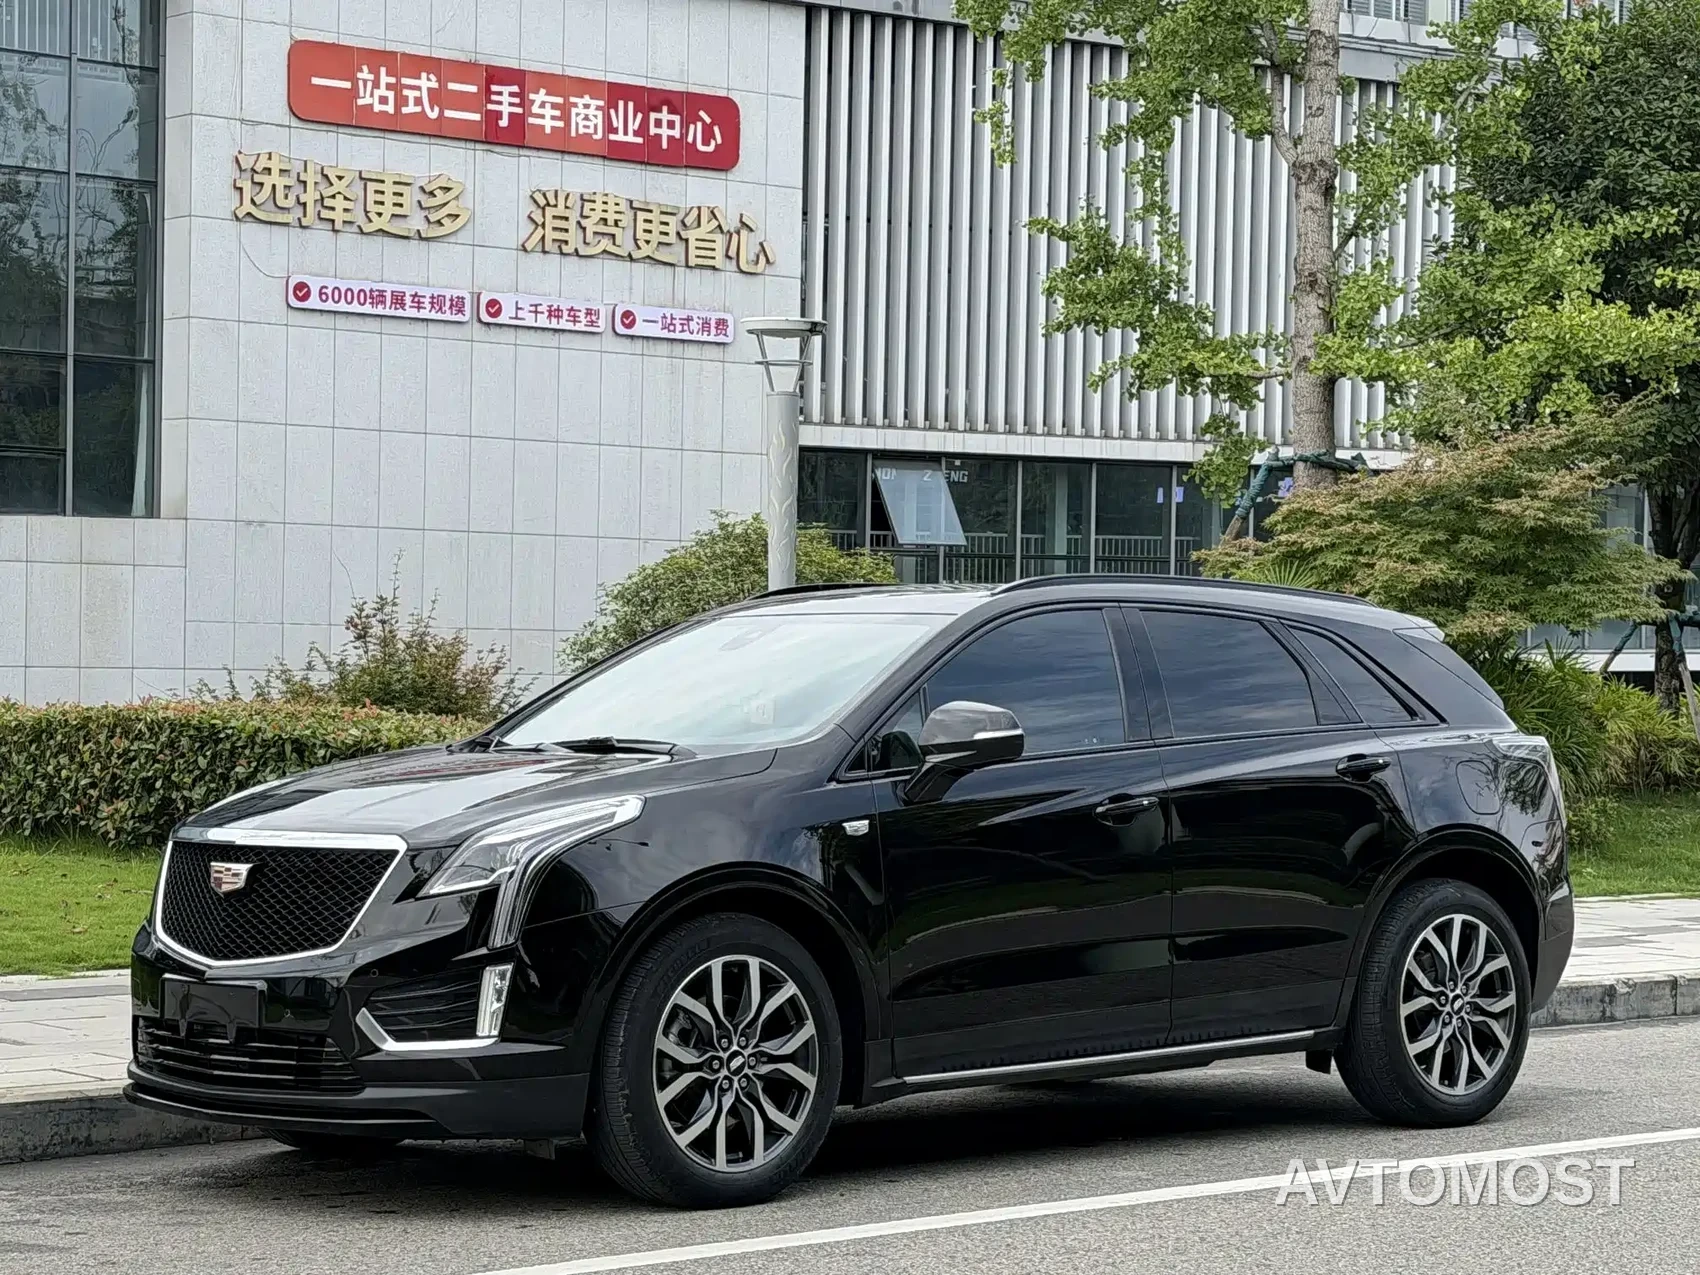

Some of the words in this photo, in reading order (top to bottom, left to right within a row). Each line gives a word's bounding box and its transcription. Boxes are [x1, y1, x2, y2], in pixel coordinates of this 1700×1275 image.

[310, 64, 723, 153] 一站式二手车商业中心
[233, 150, 473, 239] 选择更多
[521, 187, 776, 274] 消费更省心
[317, 284, 467, 317] 6000辆展车规模
[508, 300, 601, 328] 上千种车型
[641, 312, 730, 338] 一站式消费
